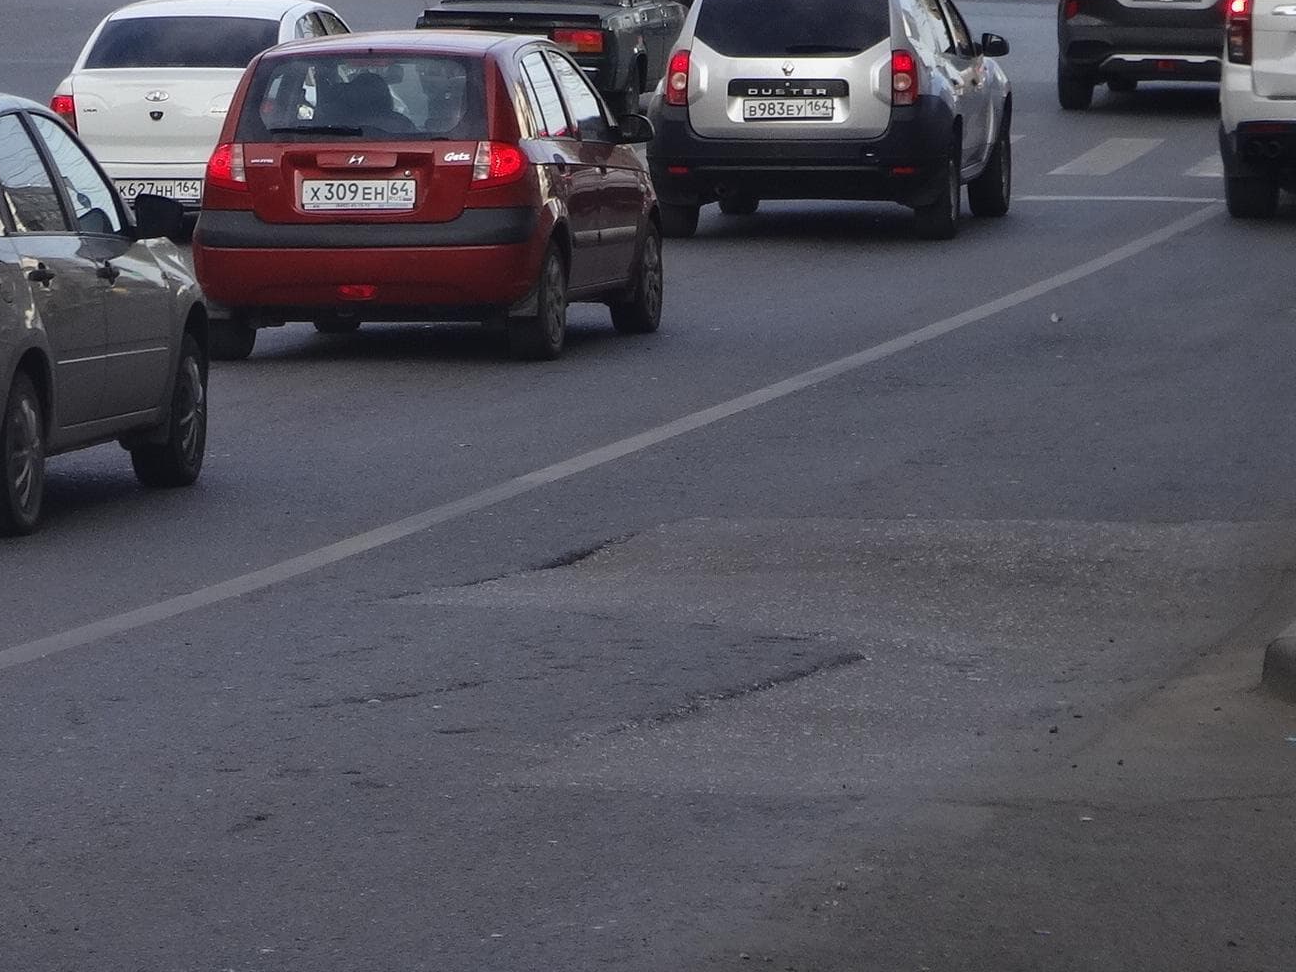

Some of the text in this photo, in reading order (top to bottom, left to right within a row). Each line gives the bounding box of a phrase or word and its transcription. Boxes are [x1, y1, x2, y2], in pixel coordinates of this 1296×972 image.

[807, 100, 830, 112] 164
[443, 151, 471, 163] Getz
[176, 181, 199, 193] 164
[390, 182, 409, 196] 64
